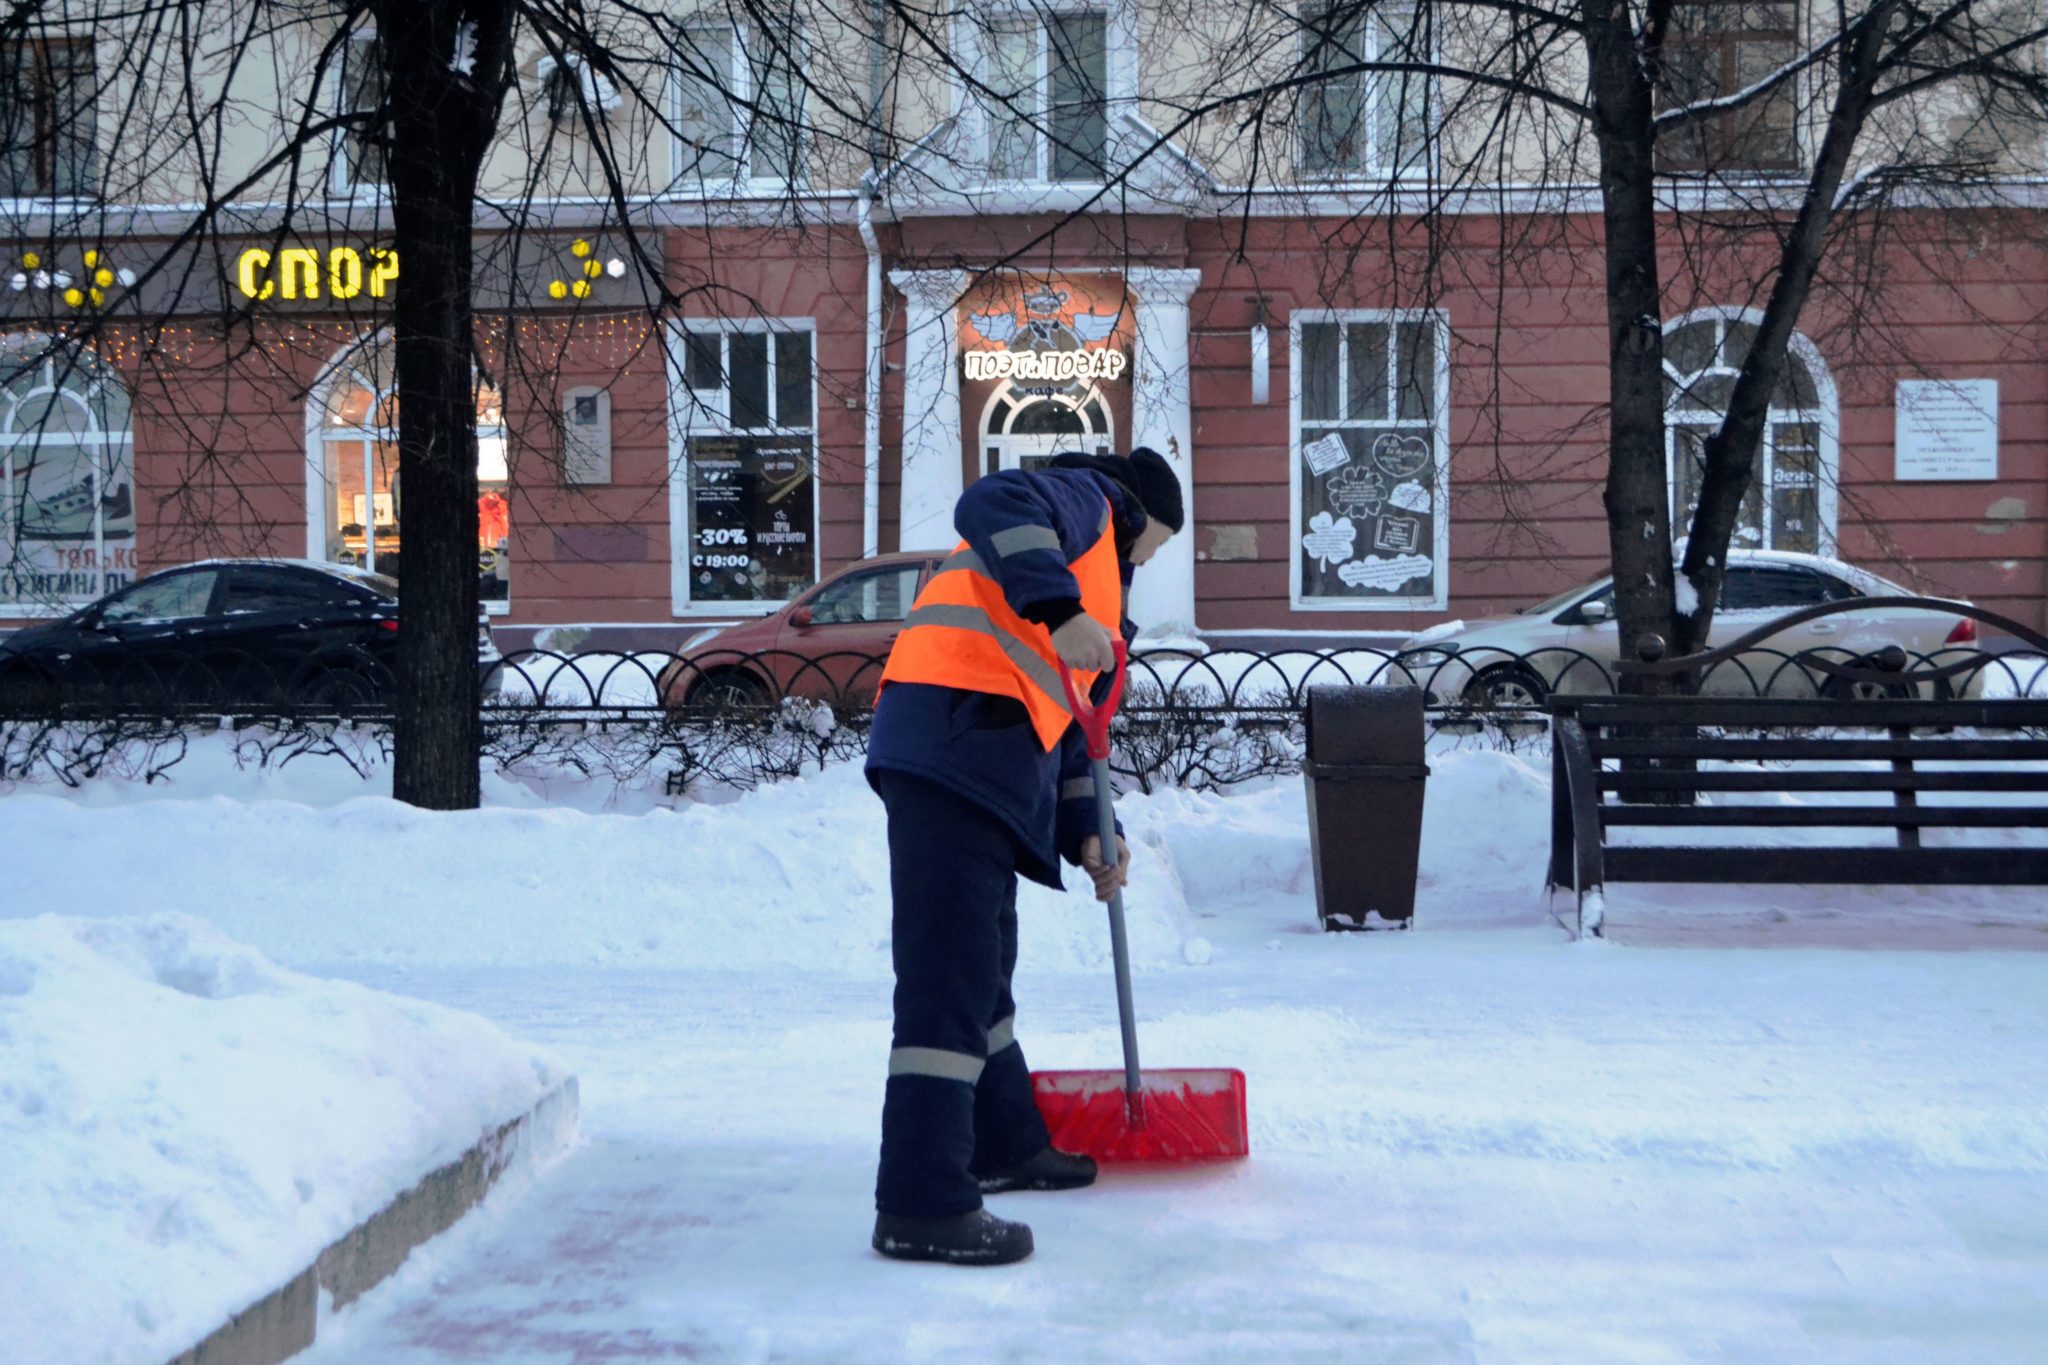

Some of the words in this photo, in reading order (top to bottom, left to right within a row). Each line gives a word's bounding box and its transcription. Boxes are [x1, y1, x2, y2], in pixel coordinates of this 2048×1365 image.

[239, 247, 399, 299] СПОР
[966, 351, 1032, 380] ПОЭТ
[1042, 349, 1125, 380] ПОВАР
[1025, 386, 1063, 397] кафе
[693, 528, 748, 546] -30%
[706, 554, 749, 568] 19:00
